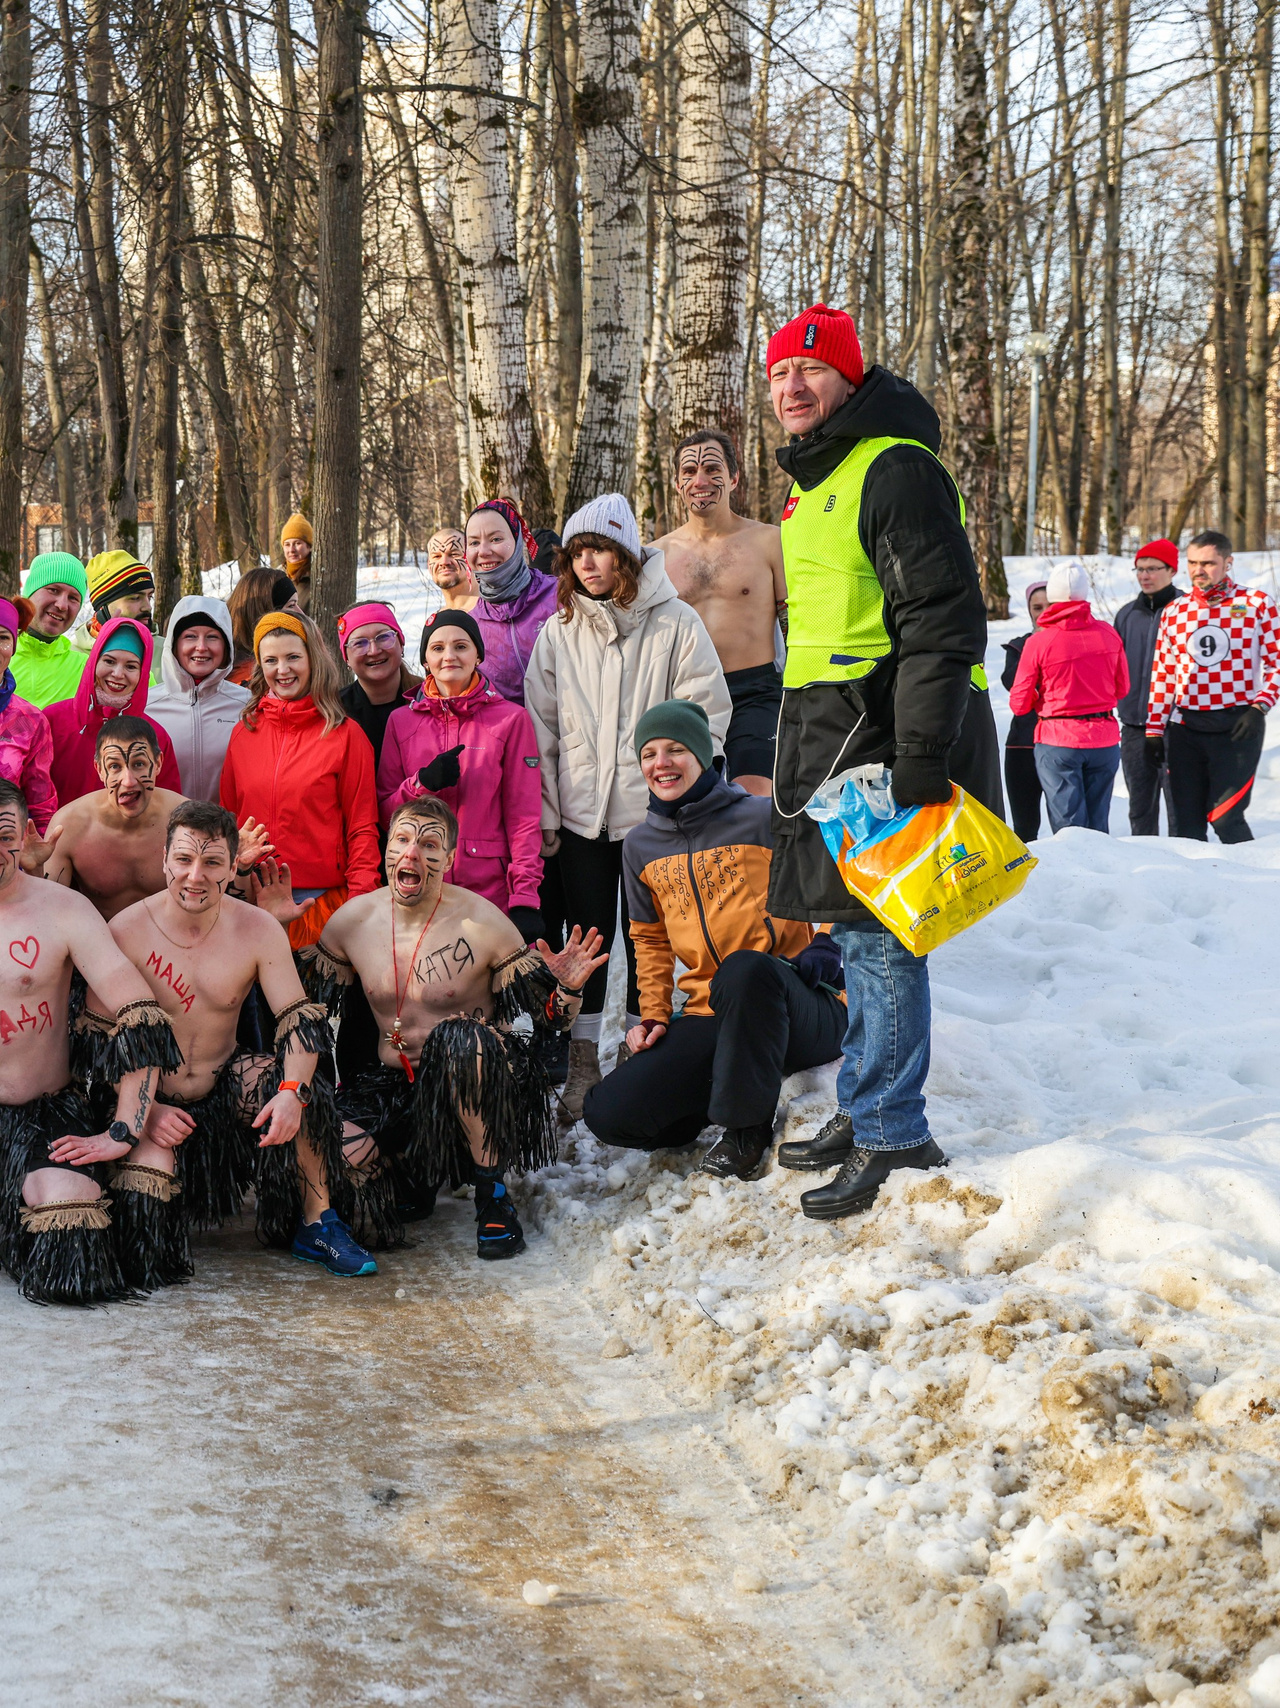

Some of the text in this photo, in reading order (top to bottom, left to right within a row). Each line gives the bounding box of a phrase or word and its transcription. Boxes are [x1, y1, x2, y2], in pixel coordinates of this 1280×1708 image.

[1199, 634, 1217, 657] 9
[146, 950, 196, 1014] МАША
[413, 936, 475, 985] КАТЯ
